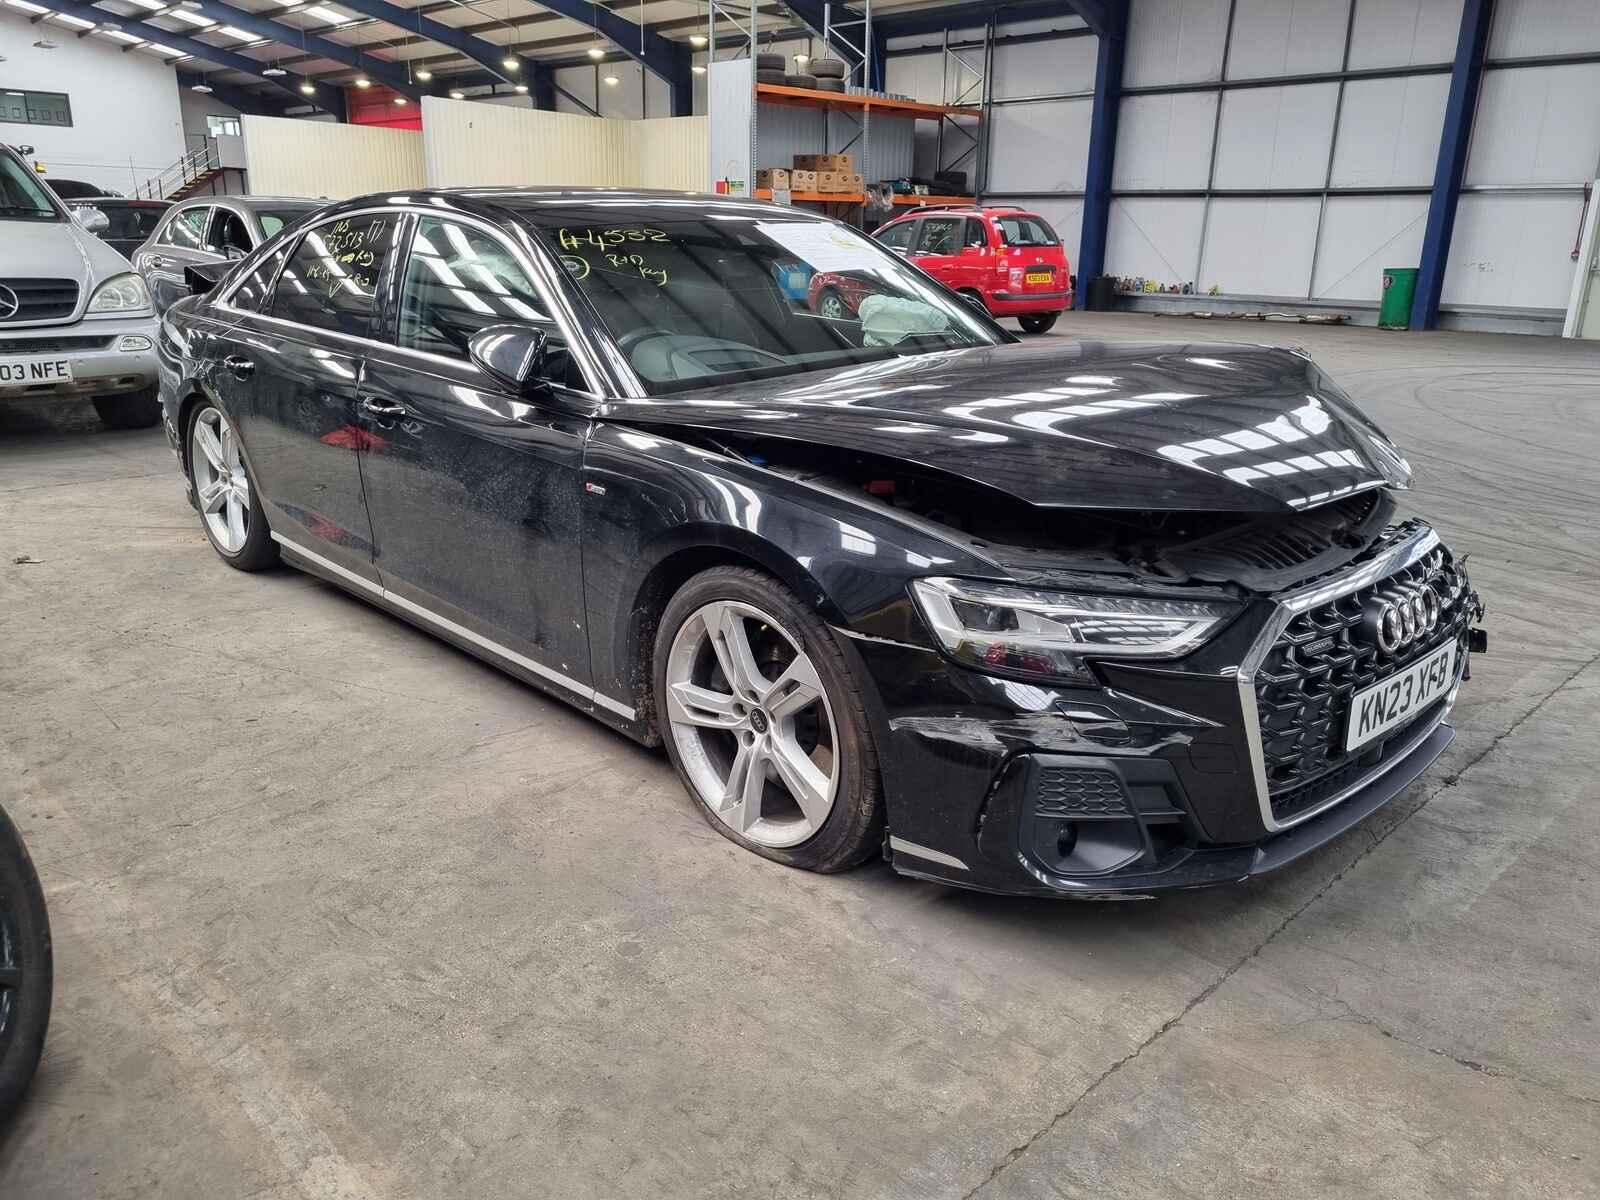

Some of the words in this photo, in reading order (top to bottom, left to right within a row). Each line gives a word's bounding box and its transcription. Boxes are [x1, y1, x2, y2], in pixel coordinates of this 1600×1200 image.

[30, 360, 68, 379] NFE
[1358, 674, 1414, 738] KN23
[1415, 652, 1449, 704] XFB
